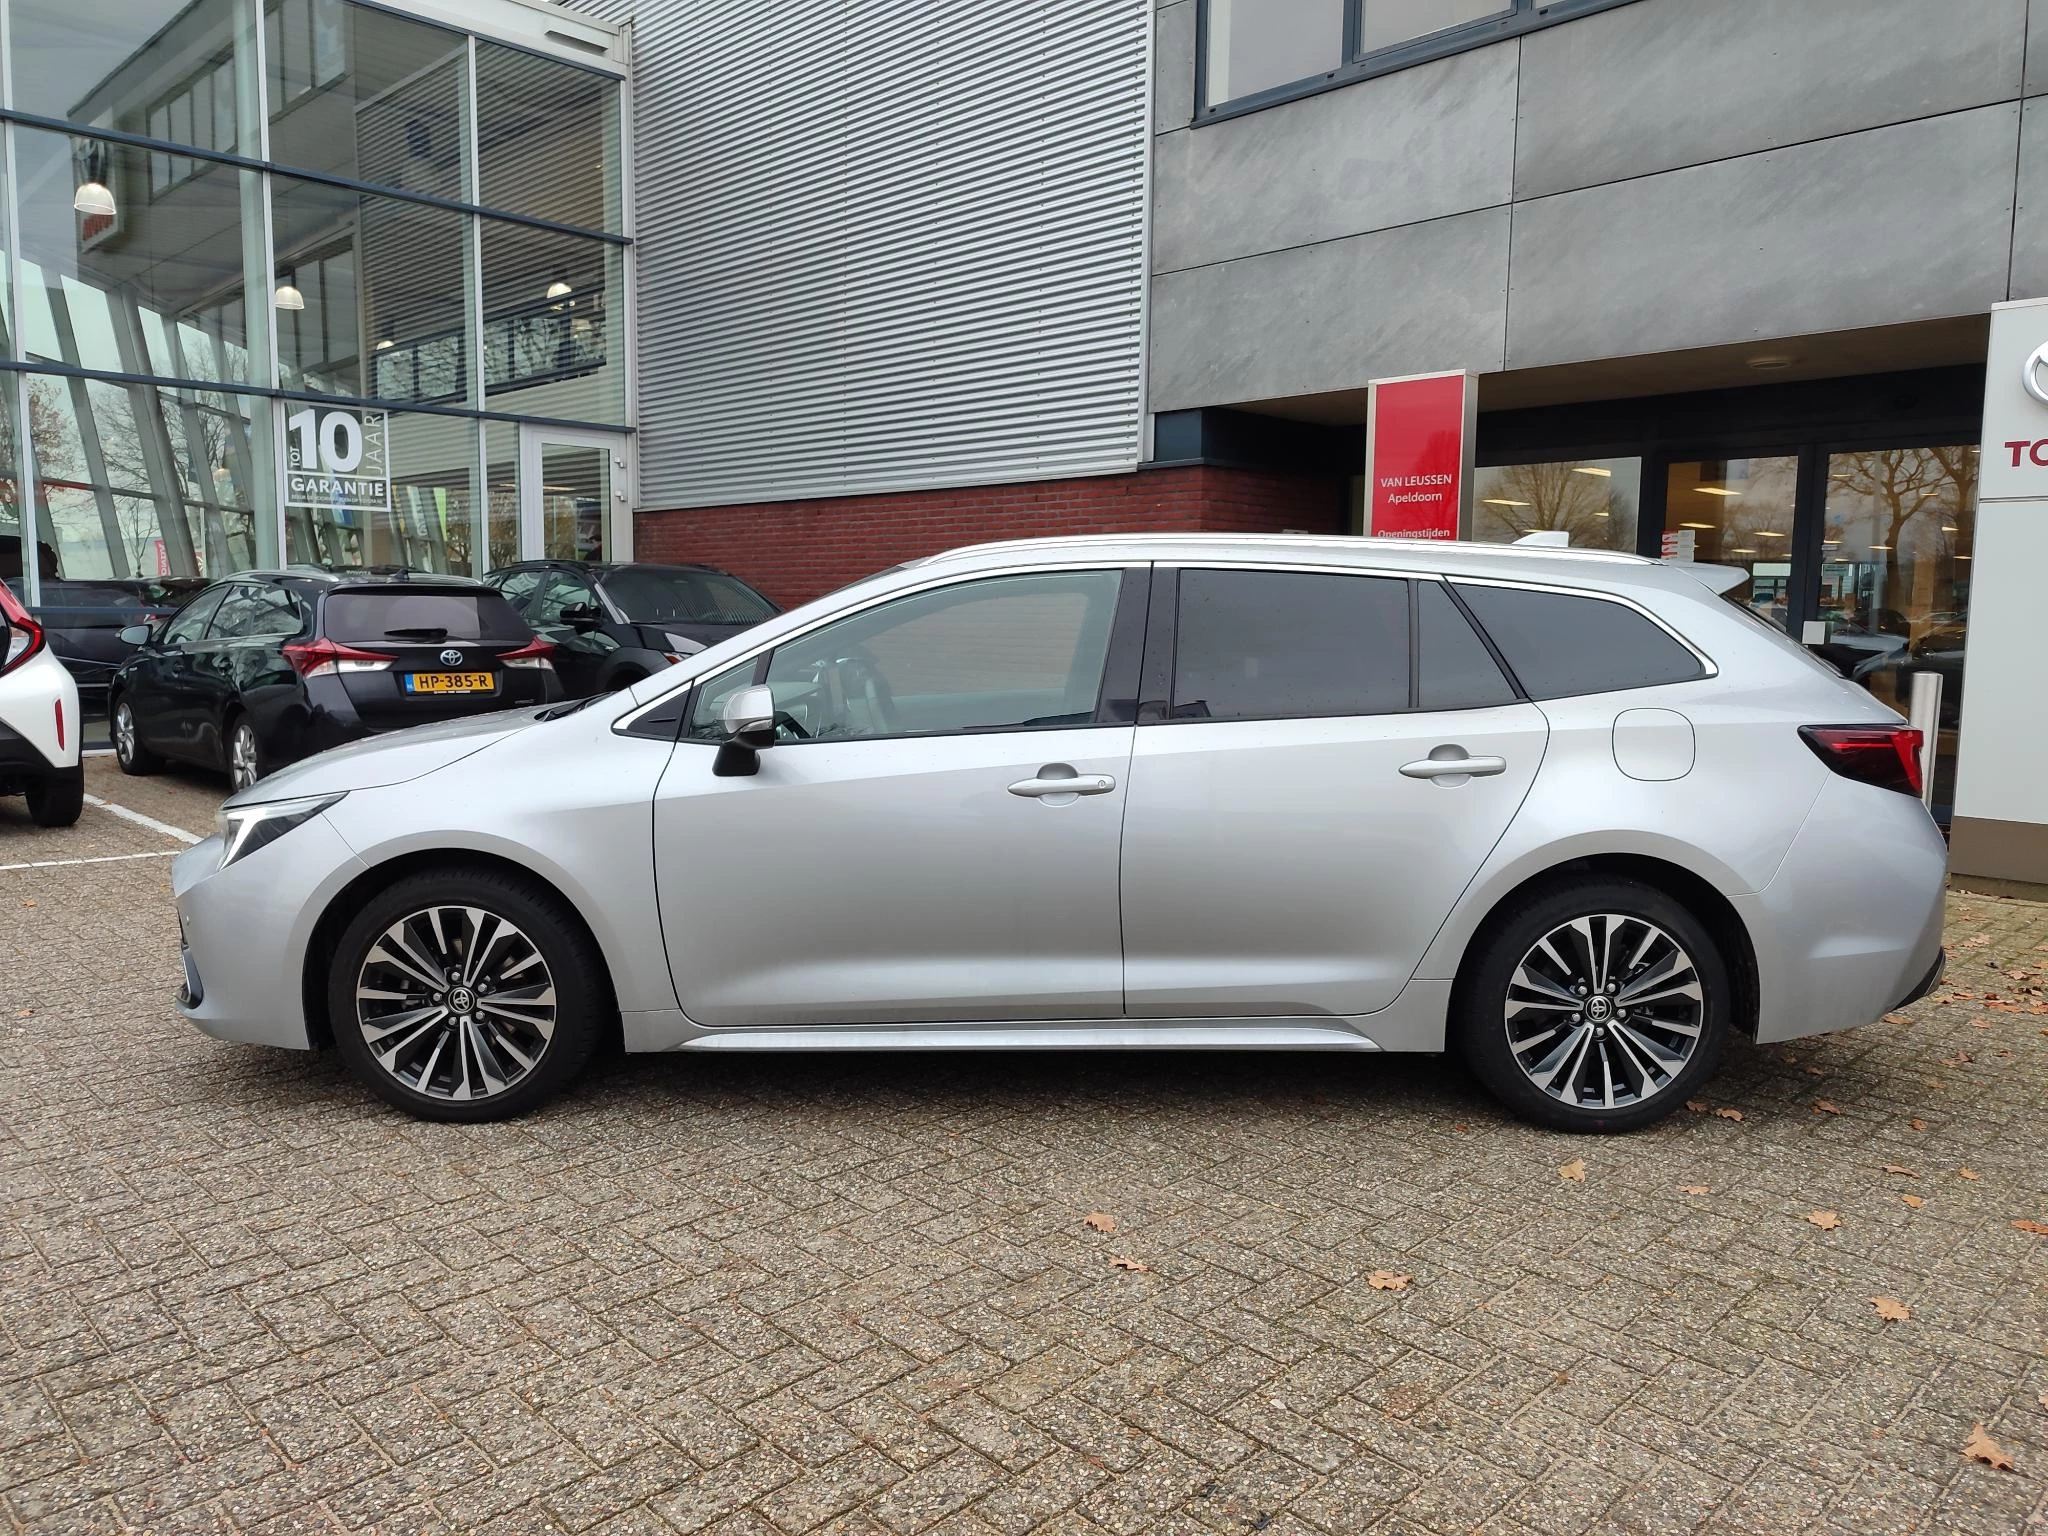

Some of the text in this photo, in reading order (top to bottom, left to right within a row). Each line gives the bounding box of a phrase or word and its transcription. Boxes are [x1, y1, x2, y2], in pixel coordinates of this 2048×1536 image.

[289, 409, 362, 472] 10
[364, 415, 383, 475] JAAR
[290, 446, 300, 467] TOT
[291, 477, 384, 497] GARANTIE
[1380, 474, 1452, 488] VAN LEUSSEN
[1387, 492, 1442, 505] Apeldoorn
[419, 675, 488, 688] HP-385-R
